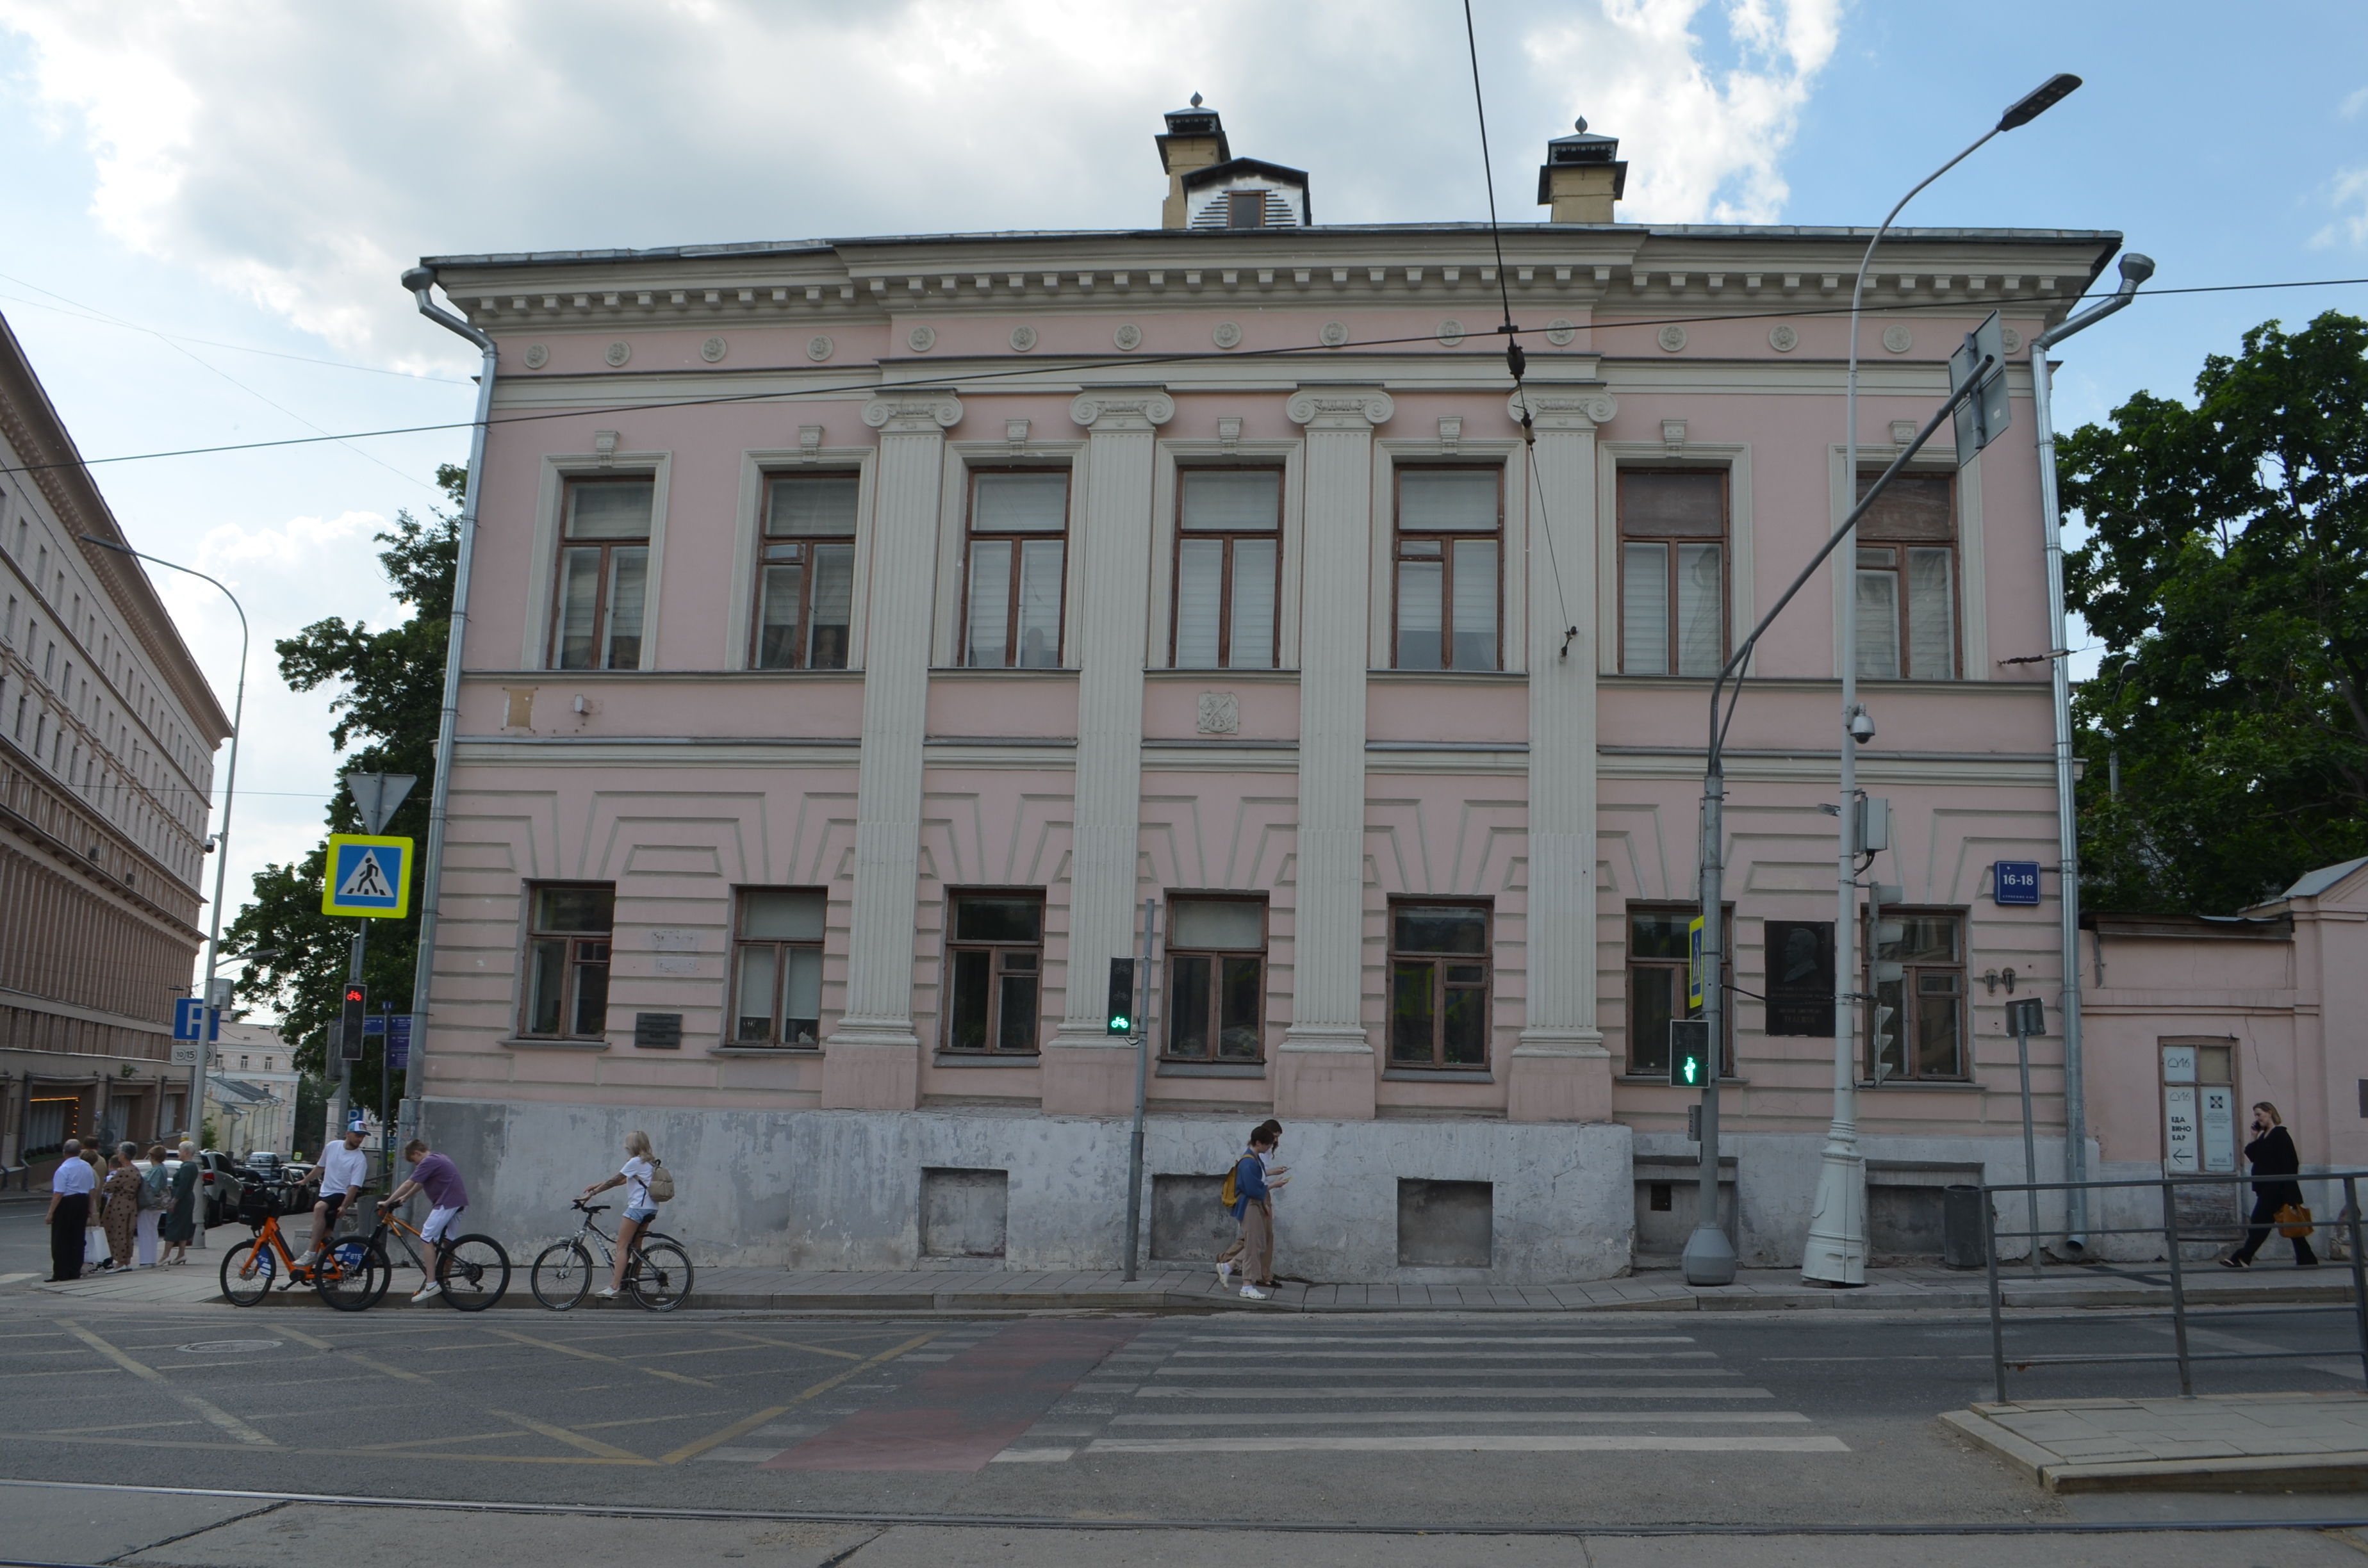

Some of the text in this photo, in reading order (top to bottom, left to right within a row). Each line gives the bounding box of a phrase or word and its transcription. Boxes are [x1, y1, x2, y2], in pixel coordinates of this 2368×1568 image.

[2003, 874, 2034, 886] 16-18
[186, 1050, 195, 1059] 15
[347, 1109, 359, 1122] P
